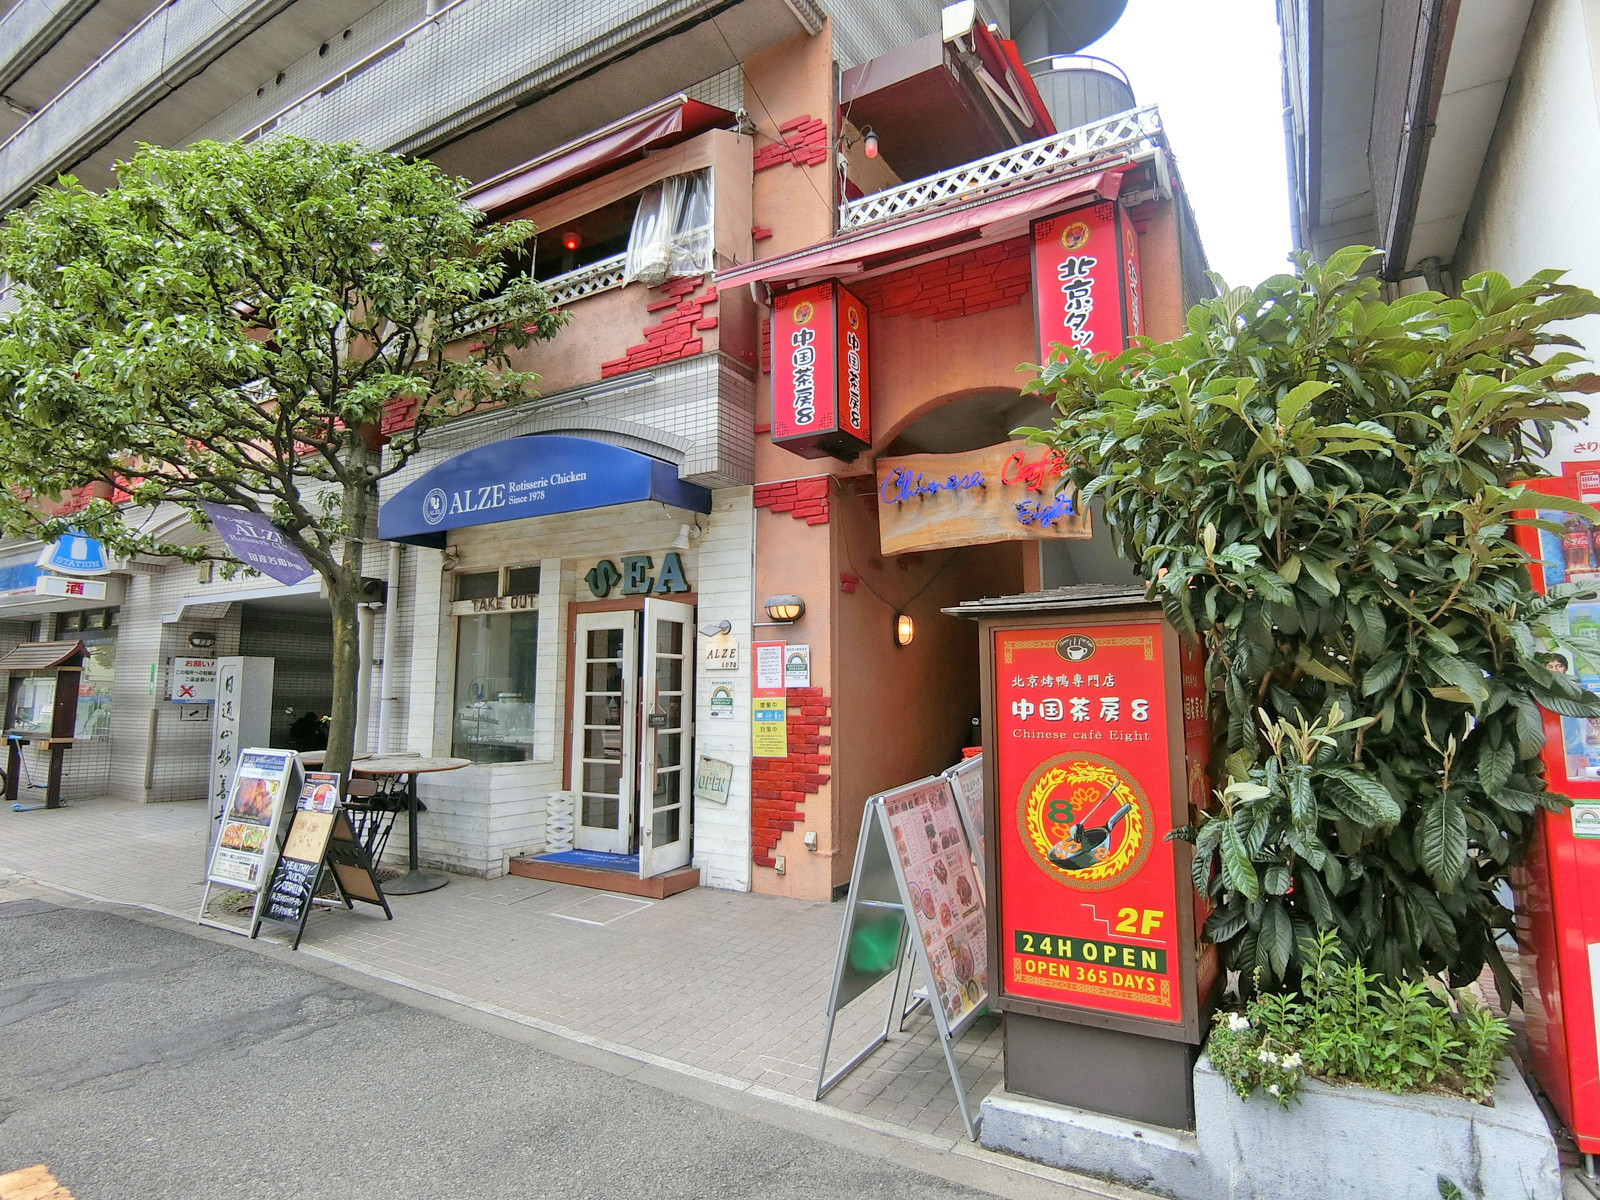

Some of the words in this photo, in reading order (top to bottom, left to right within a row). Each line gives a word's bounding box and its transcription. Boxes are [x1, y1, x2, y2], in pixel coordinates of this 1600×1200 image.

[792, 328, 815, 425] 中国茶房8
[847, 331, 860, 429] 中国茶房8
[509, 477, 549, 493] Rotisserie
[550, 471, 587, 486] Chicken
[881, 467, 985, 504] Chinese
[449, 484, 506, 515] ALZE
[509, 495, 528, 505] Since
[529, 490, 545, 502] 1978
[1018, 494, 1076, 528] Eight
[55, 556, 100, 568] STATION
[584, 552, 691, 597] SEA
[65, 581, 85, 596] 酒
[472, 597, 505, 613] TAKE
[511, 594, 537, 609] OUT
[707, 648, 737, 660] ALZE
[1011, 673, 1116, 688] 北京烤鴨専門店
[1012, 729, 1068, 740] Chinese
[1109, 730, 1150, 742] Eight
[698, 775, 726, 792] OPEN
[1115, 907, 1164, 935] 2F
[1022, 934, 1072, 958] 24H
[1082, 942, 1157, 970] OPEN
[1025, 959, 1070, 978] OPEN
[1076, 966, 1108, 984] 365
[1112, 972, 1155, 992] DAYS
